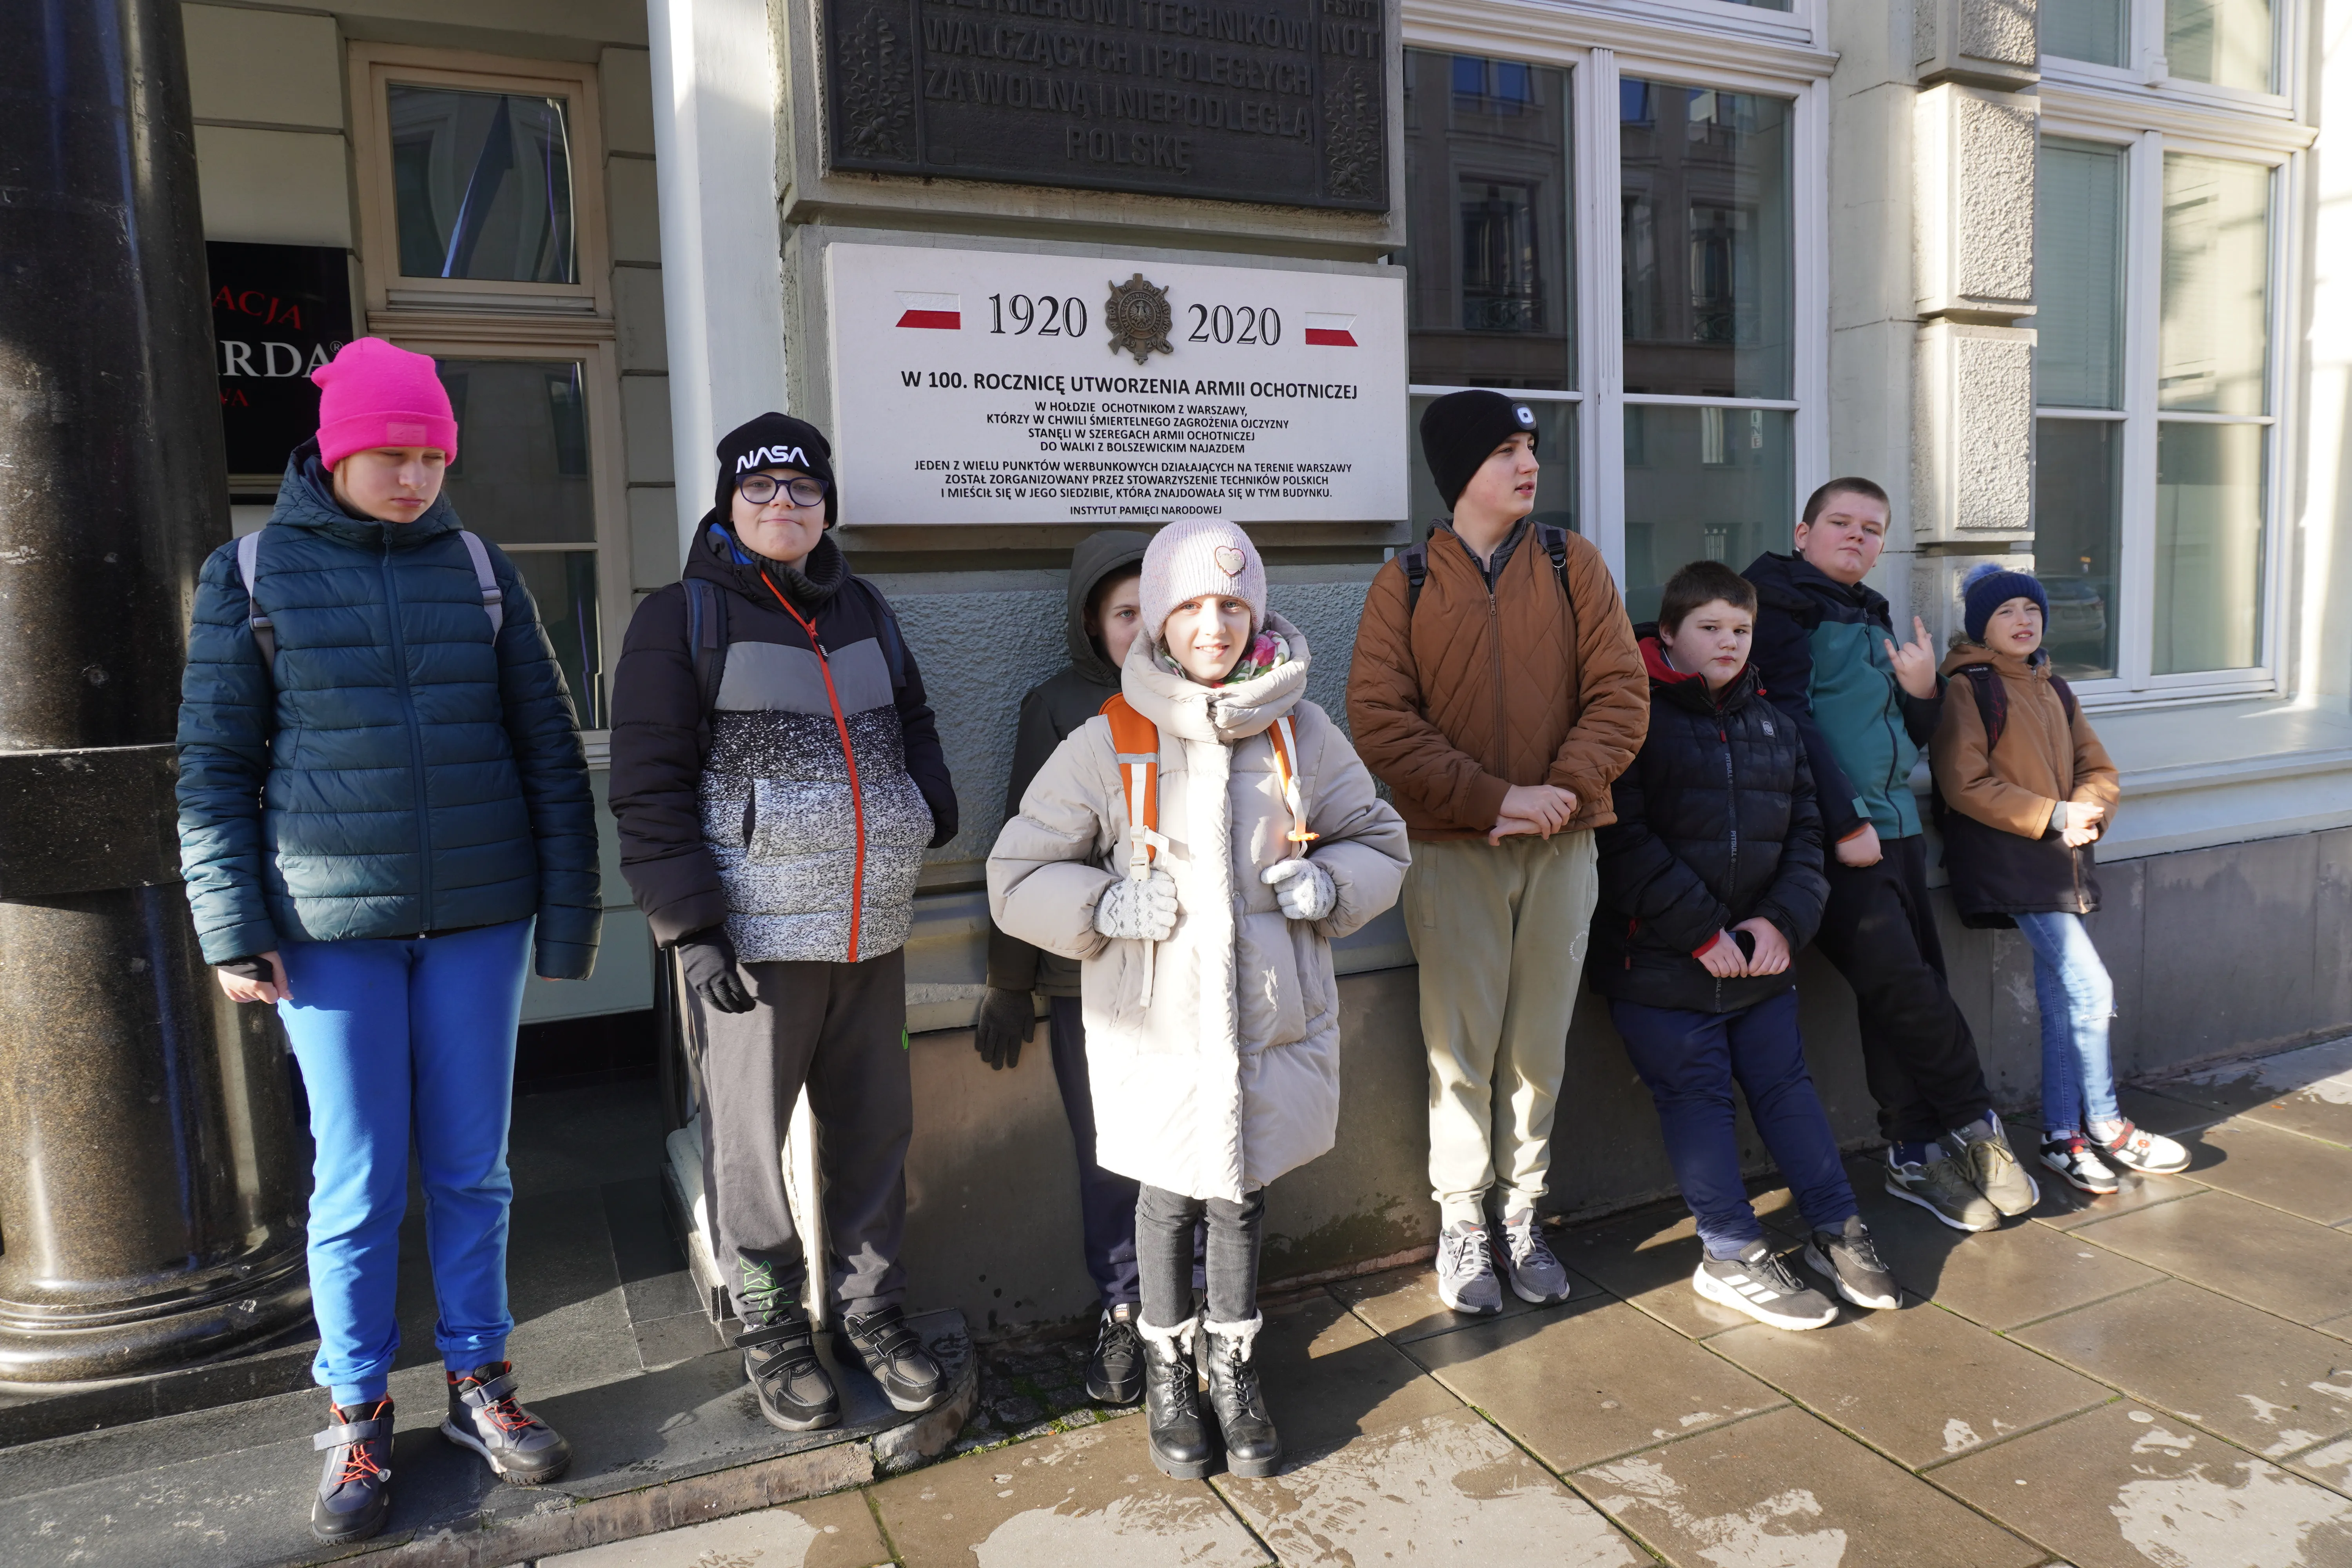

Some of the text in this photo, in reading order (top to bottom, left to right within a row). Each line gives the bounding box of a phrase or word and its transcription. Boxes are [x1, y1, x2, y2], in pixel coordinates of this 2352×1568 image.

[1141, 0, 1310, 51] TECHNIKÓW
[1322, 21, 1379, 58] NOT
[923, 17, 1311, 96] WALCZĄCYCH I POLEGŁYCH
[924, 64, 1312, 145] ZA WOLNĄ I NIEPODLEGŁĄ
[1066, 126, 1193, 175] POLSKĘ
[989, 293, 1087, 338] 1920
[1188, 303, 1281, 346] 2020
[901, 371, 1357, 399] W 100. ROCZNICĘ UTWORZENIA ARMII OCHOTNICZEJ
[987, 411, 1289, 429] KTÓRZY W CHWILI ŚMIERTELNEGO ZAGROŻENIA OJCZYZNY
[1034, 401, 1247, 418] W HOŁDZIE OCHOTNIKOM Z WARSZAWY,
[1028, 428, 1255, 441] STANĘLI W SZEREGACH ARMII OCHOTNICZEJ
[1040, 441, 1245, 453] DO WALKI Z BOLSZEWICKIM NAJAZDEM
[735, 445, 810, 474] NASA
[915, 459, 1352, 474] JEDEN Z WIELU PUNKTÓW WERBUNKOWYCH DZIAŁAJĄCYCH NA TERENIE WARSZAWY
[941, 485, 1332, 500] I MIEŚCIŁ SIĘ W JEGO SIEDZIBIE, KTÓRA ZNAJDOWAŁA SIĘ W TYM BUDYNKU.
[945, 473, 1328, 485] ZOSTAŁ ZORGANIZOWANY PRZEZ STOWARZYSZENIE TECHNIKÓW POLSKICH
[1070, 506, 1221, 517] INSTYTUT PAMIĘCI NARODOWEJ
[1725, 752, 1733, 779] PITBULL
